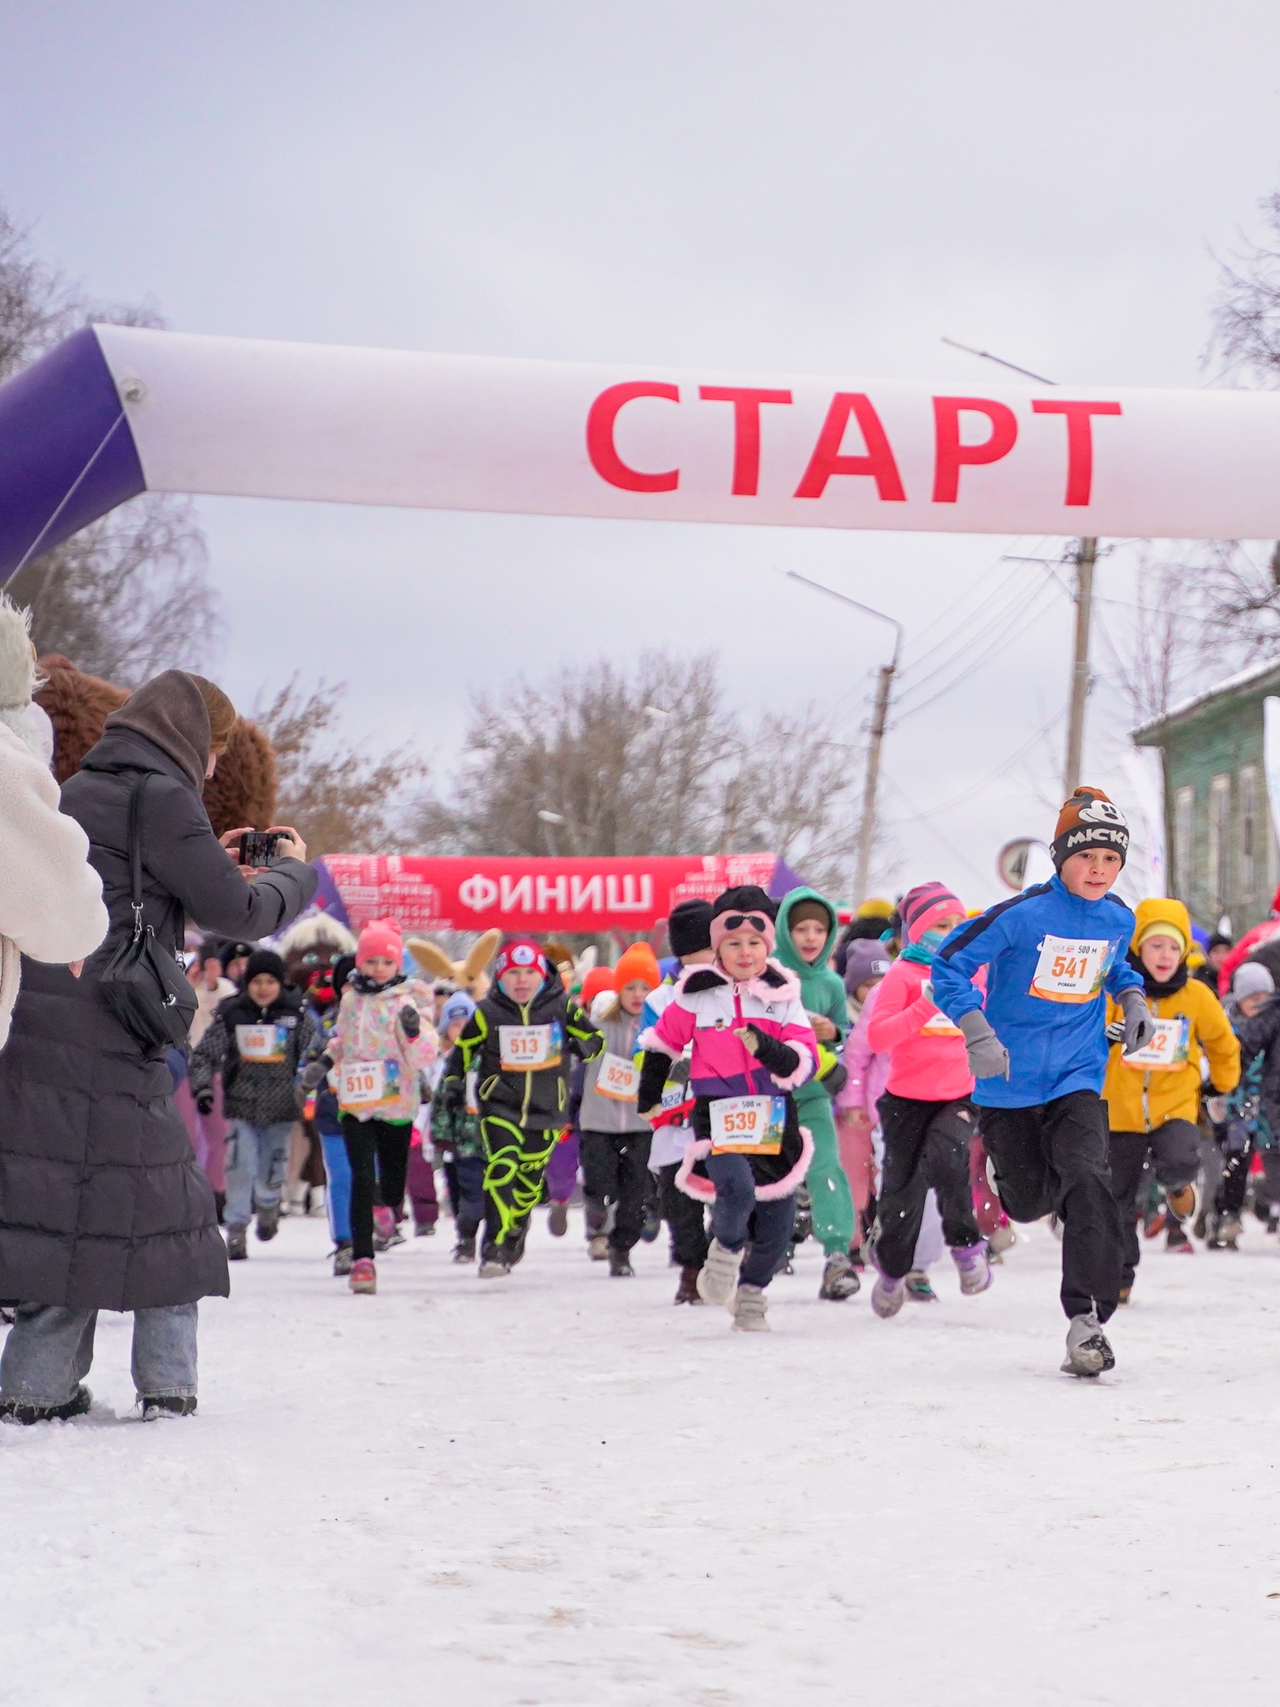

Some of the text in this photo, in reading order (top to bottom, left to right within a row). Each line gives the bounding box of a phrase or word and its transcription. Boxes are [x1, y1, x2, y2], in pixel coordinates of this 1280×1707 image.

[586, 381, 1122, 506] СТАРТ
[458, 873, 653, 915] ФИНИШ
[1078, 945, 1091, 954] 500
[1051, 955, 1088, 979] 541
[510, 1037, 538, 1054] 513
[346, 1074, 374, 1093] 510
[607, 1066, 633, 1087] 529
[723, 1111, 757, 1133] 539
